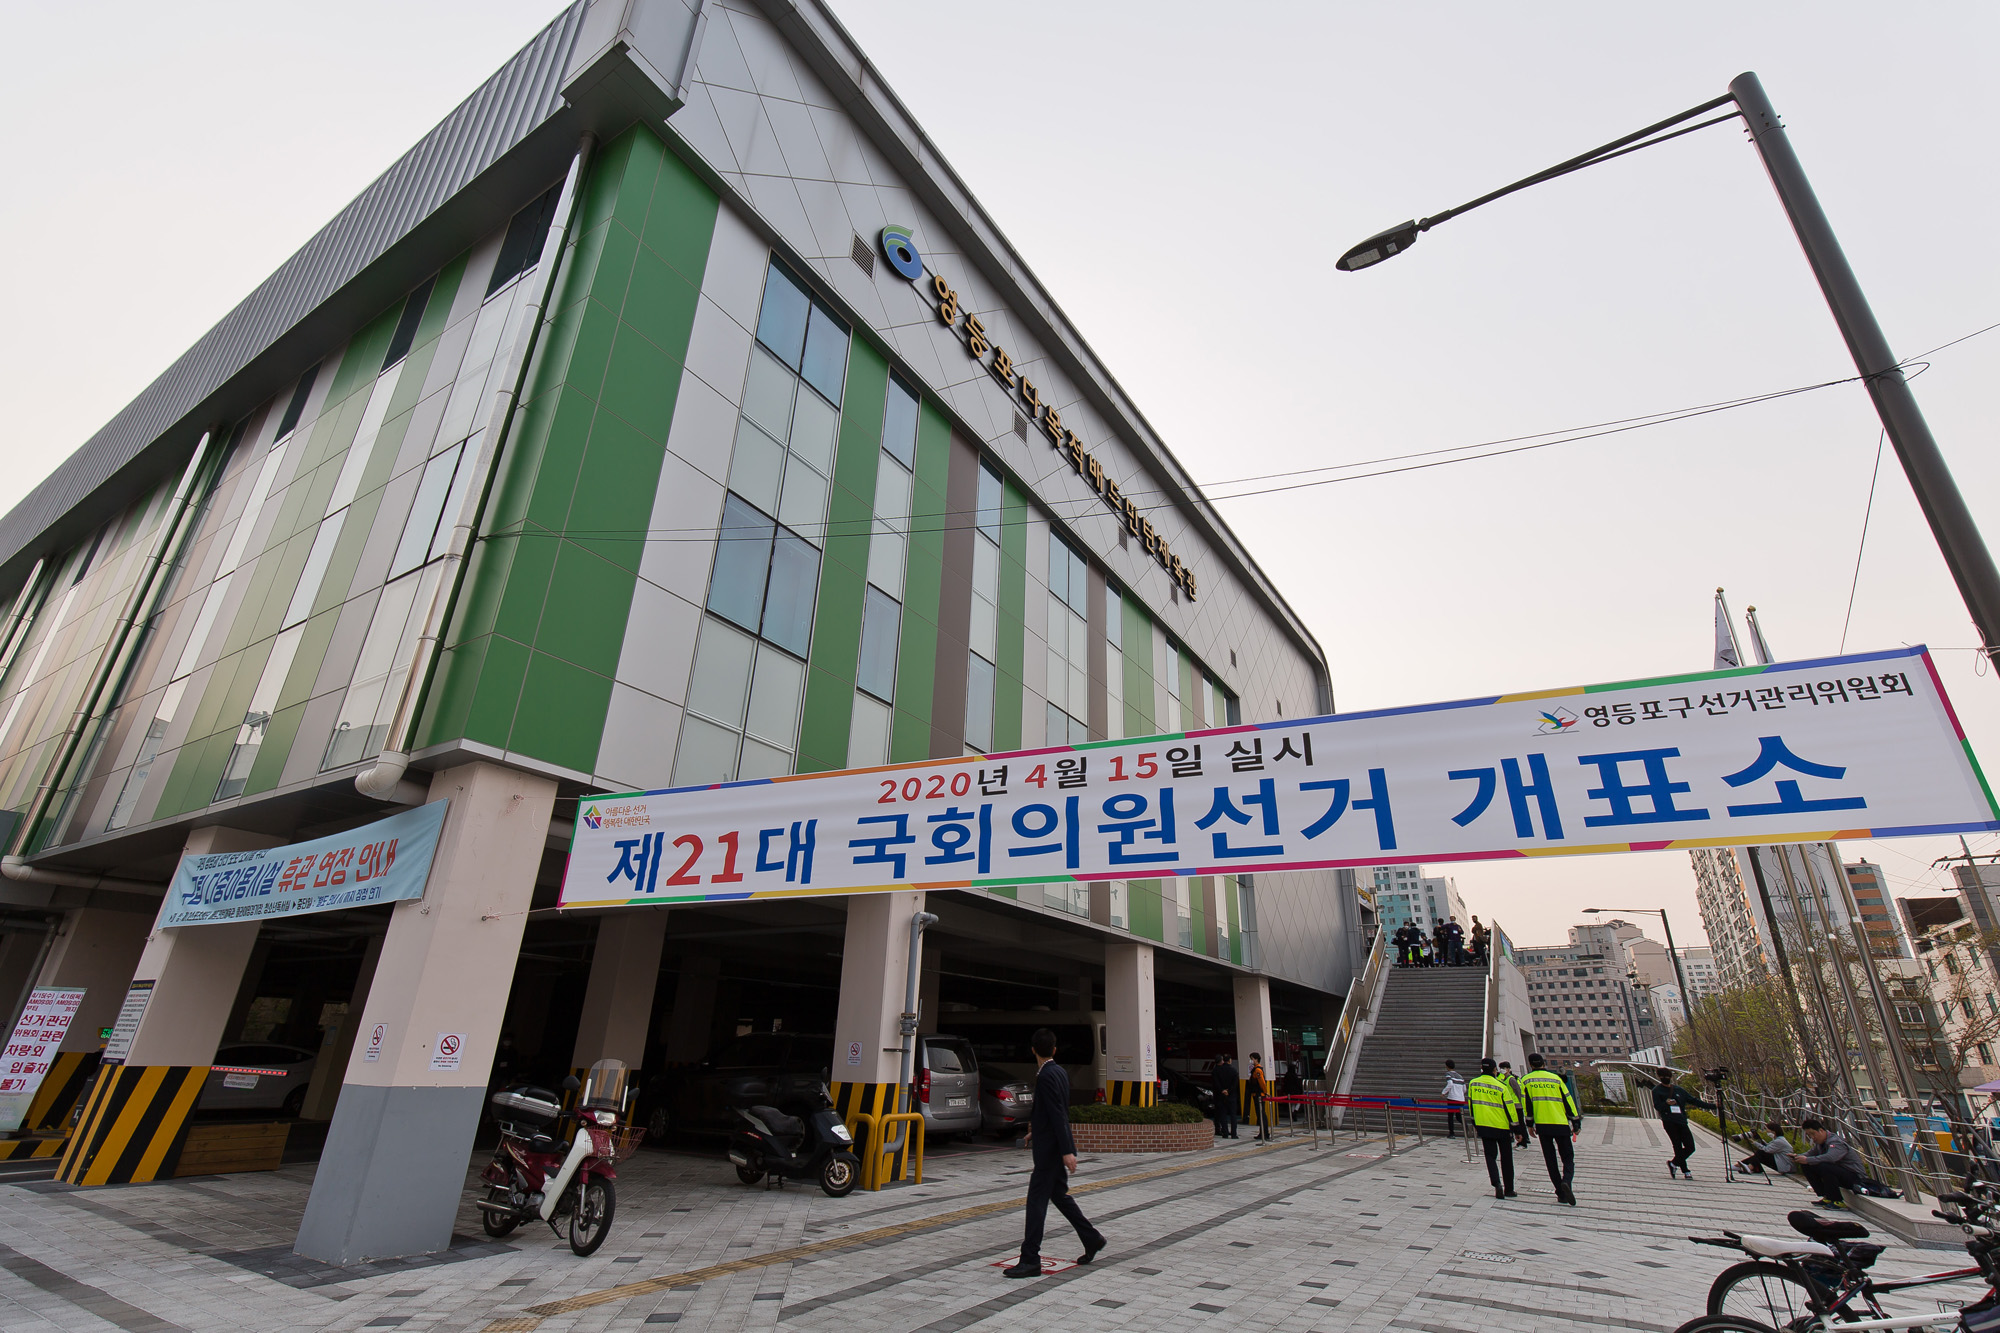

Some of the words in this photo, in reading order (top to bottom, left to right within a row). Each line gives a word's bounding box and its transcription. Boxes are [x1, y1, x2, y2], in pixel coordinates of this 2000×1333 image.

[1583, 672, 1914, 728] 영등포구선거관리위원회
[877, 765, 1008, 804] 2020년
[1024, 756, 1088, 789] 4월
[1108, 744, 1204, 782] 15일
[1225, 732, 1314, 773] 실시
[603, 816, 623, 828] 행복한
[624, 815, 650, 826] 대한민국
[605, 806, 631, 817] 아름다운
[633, 804, 647, 814] 선거
[606, 819, 818, 893] 제21대
[848, 768, 1397, 879] 국회의원선거
[1447, 735, 1867, 840] 개표소
[204, 861, 284, 904] 다중이용시설
[278, 854, 318, 893] 휴관
[313, 847, 356, 888] 연장
[356, 838, 399, 882] 안내
[14, 1028, 40, 1038] 위원회
[39, 1030, 65, 1042] 관련
[1474, 1088, 1498, 1096] POLICE
